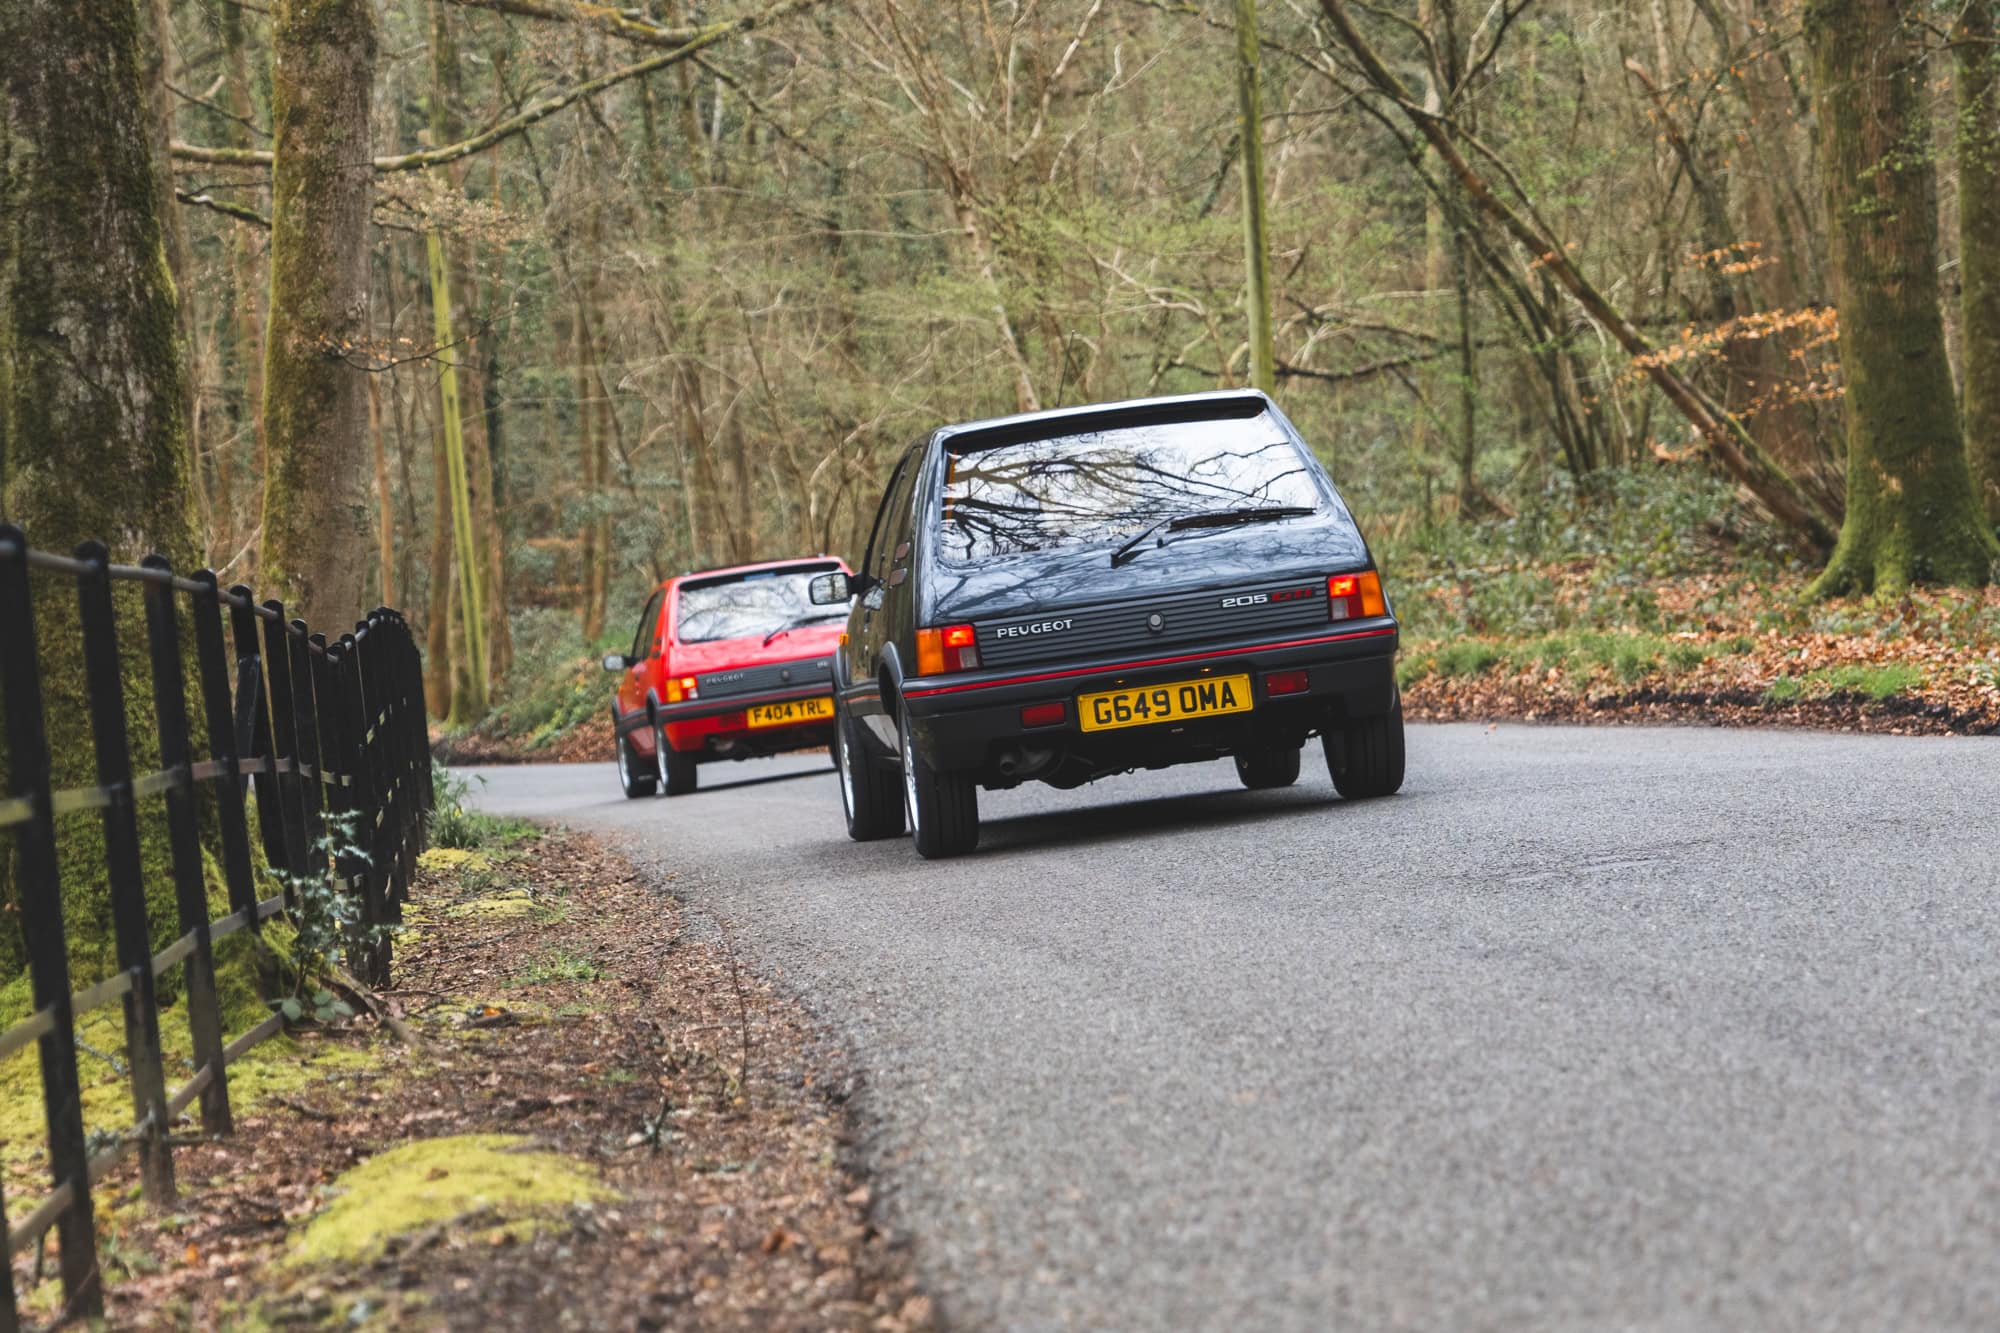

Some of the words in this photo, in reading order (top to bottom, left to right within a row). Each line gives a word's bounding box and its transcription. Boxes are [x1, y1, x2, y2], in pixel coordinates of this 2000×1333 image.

[1222, 593, 1268, 608] 205
[996, 619, 1073, 638] PEUGEOT
[706, 672, 744, 685] PEUGEOT
[753, 703, 792, 723] F404
[796, 699, 827, 716] TRL
[1093, 689, 1171, 724] G649
[1179, 681, 1238, 713] OMA
